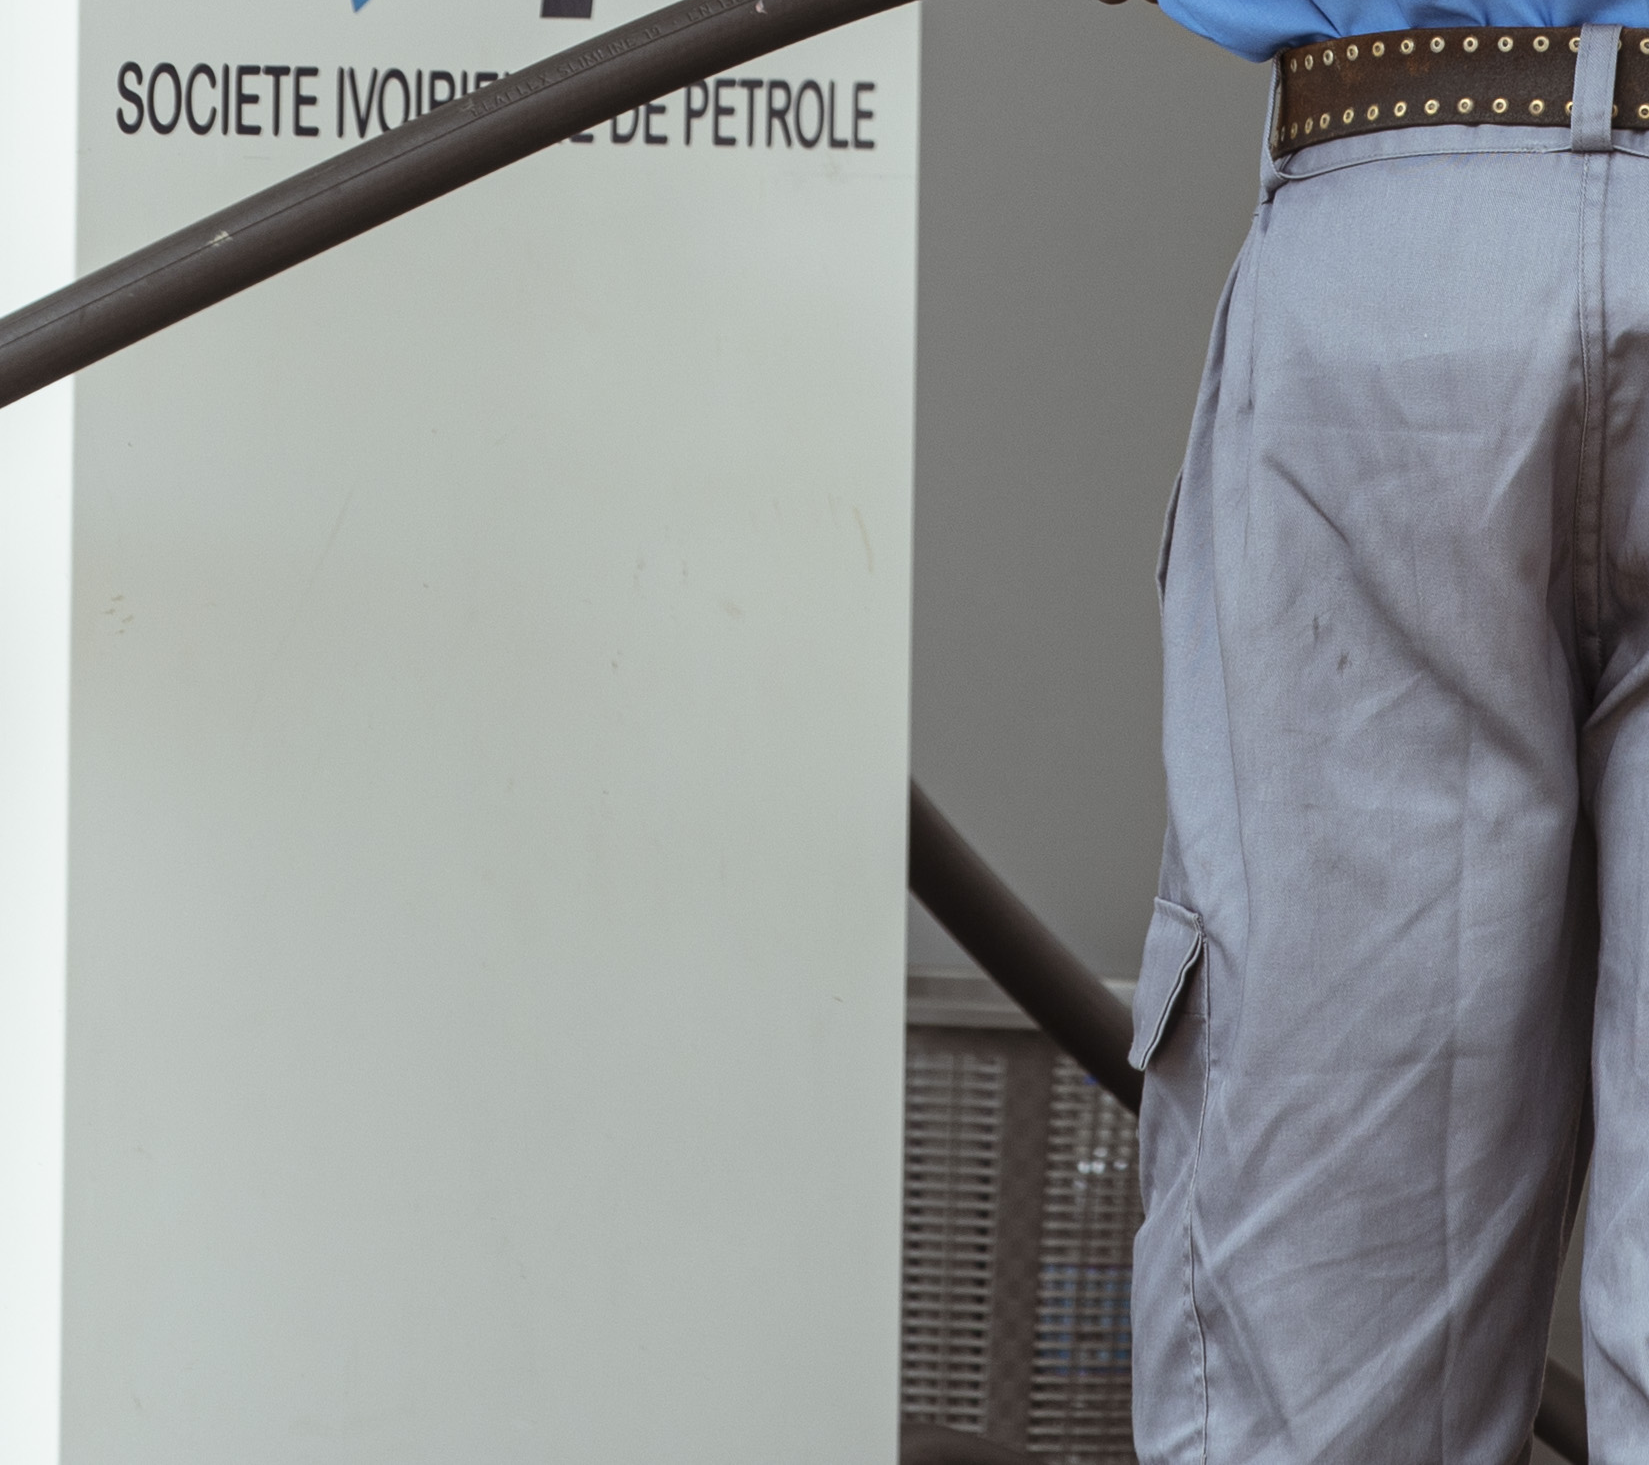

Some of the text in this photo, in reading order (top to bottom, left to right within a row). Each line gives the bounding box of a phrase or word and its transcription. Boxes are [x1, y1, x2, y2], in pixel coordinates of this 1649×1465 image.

[556, 37, 637, 75] SLIMLINE
[687, 4, 711, 22] EN
[116, 61, 320, 136] SOCIETE
[684, 76, 876, 150] PETROLE
